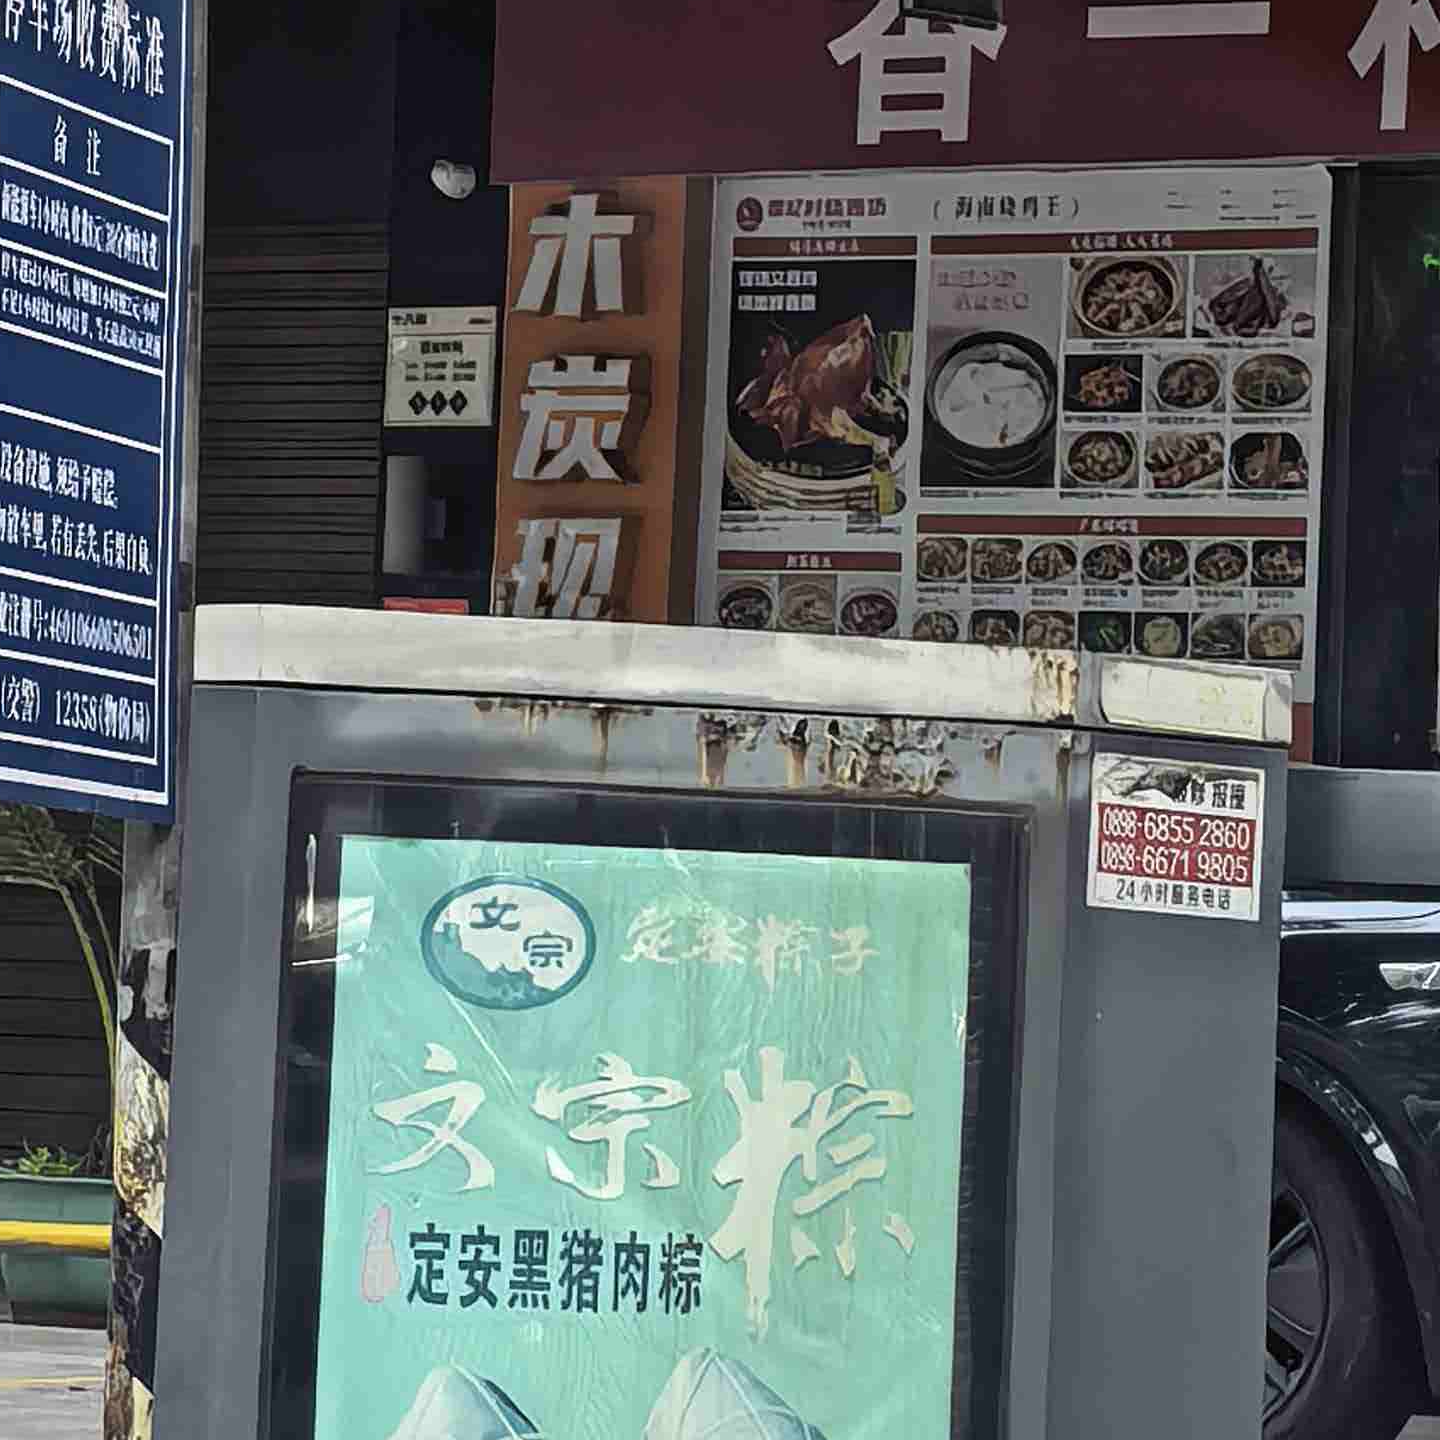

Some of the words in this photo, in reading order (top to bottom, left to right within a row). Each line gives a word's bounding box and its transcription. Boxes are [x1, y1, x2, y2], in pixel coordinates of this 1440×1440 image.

[1199, 819, 1249, 850] 2860
[1198, 852, 1249, 882] 9805
[406, 1223, 704, 1314] 定安黑猪肉粽
